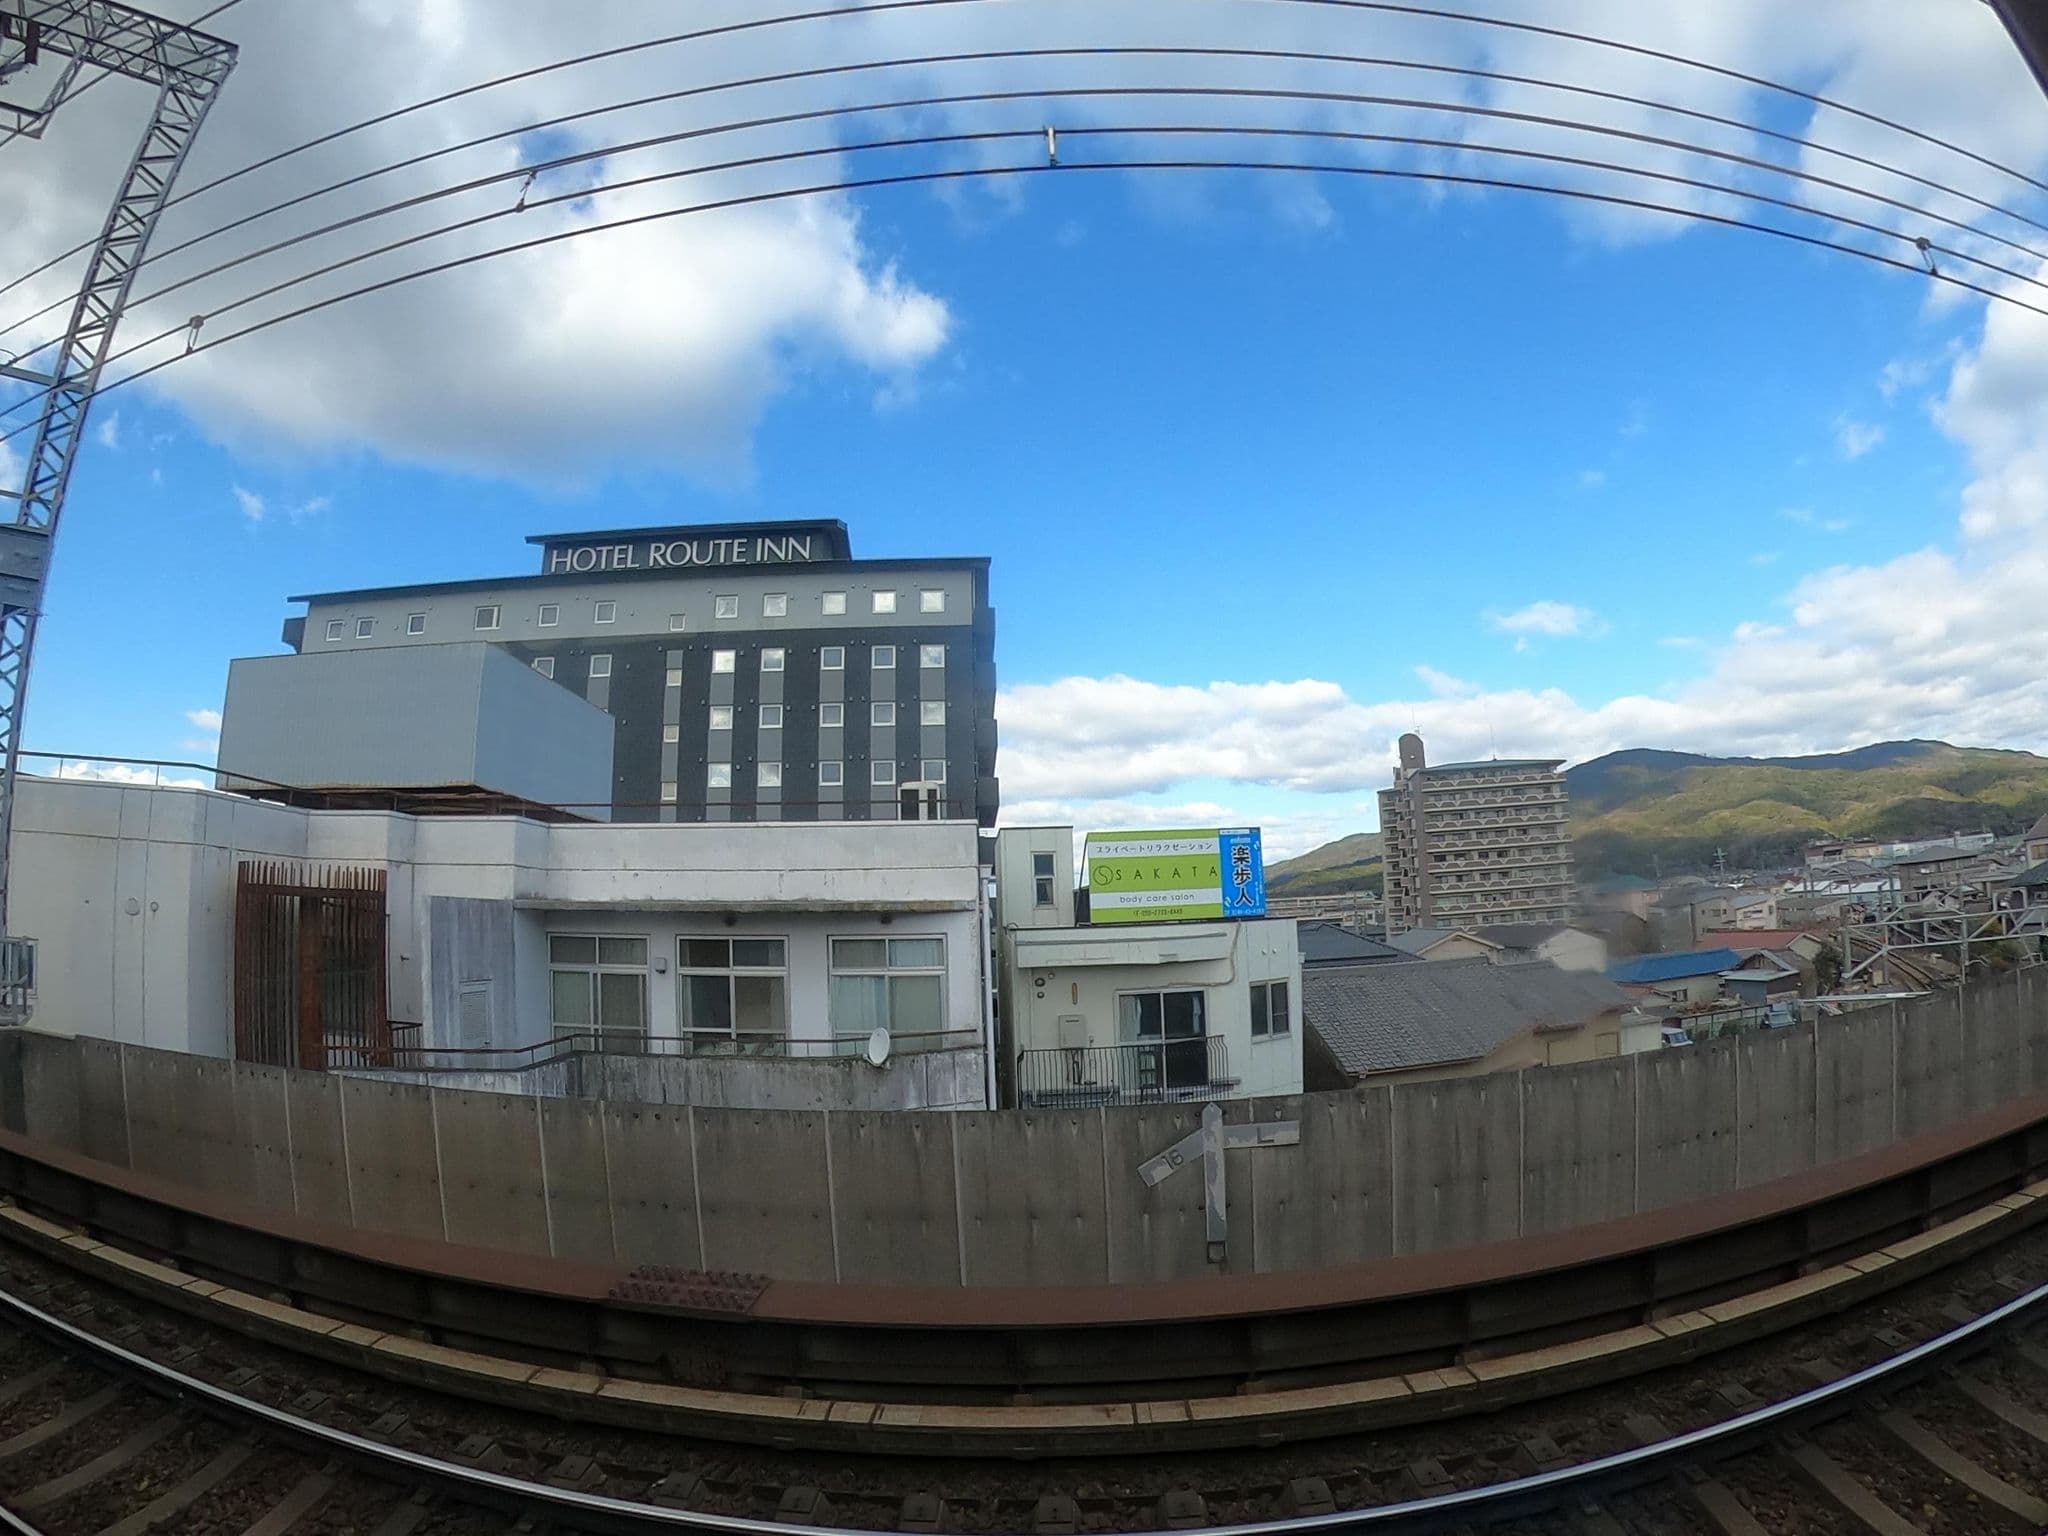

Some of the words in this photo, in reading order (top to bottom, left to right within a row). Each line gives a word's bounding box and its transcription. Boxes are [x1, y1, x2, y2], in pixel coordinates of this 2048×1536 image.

[550, 544, 640, 573] HOTEL
[648, 538, 748, 567] ROUTE
[755, 536, 812, 563] INN
[1115, 866, 1218, 881] SAKATA
[1231, 845, 1254, 907] 楽歩人
[1119, 895, 1142, 903] body
[1171, 893, 1195, 901] salon
